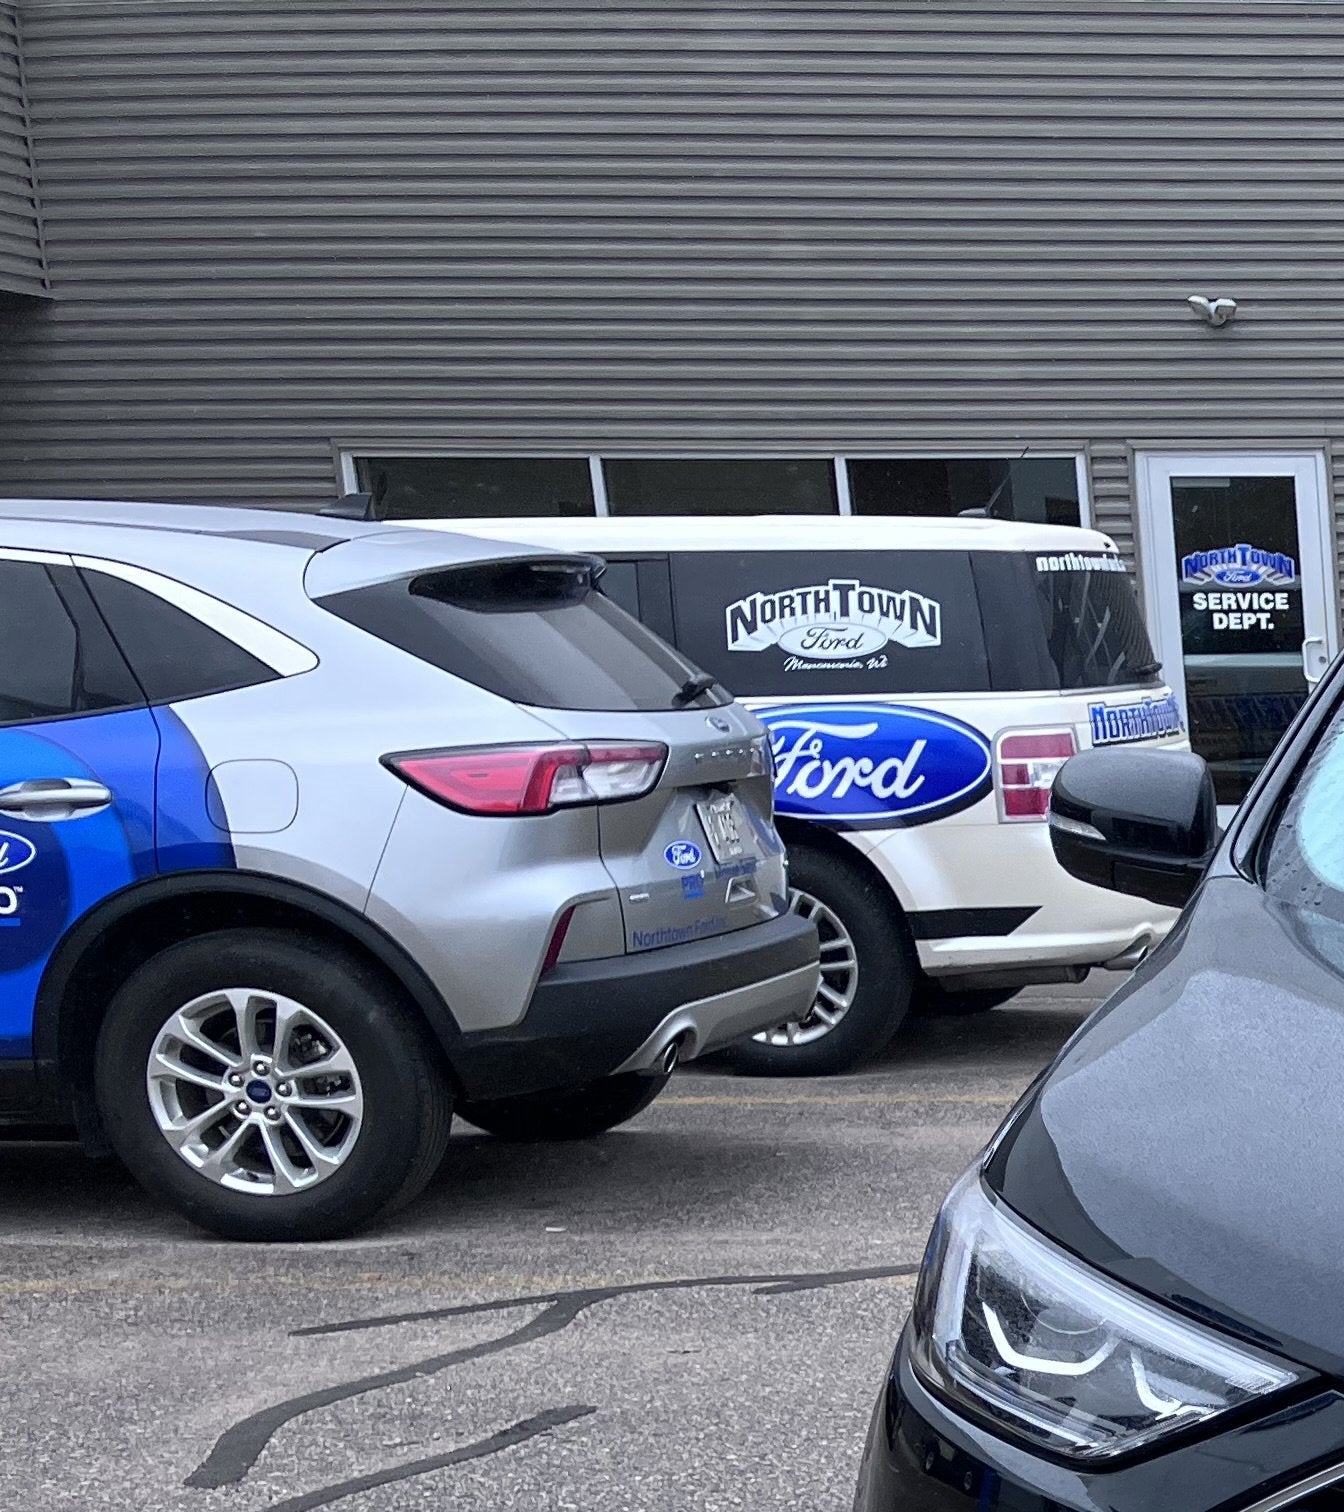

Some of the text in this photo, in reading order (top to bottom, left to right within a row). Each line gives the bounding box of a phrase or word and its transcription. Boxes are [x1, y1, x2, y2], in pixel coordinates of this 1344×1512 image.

[1193, 592, 1289, 610] SERVICE
[1212, 612, 1275, 630] DEPT.
[799, 626, 865, 651] Ford
[769, 720, 927, 799] Ford
[671, 844, 697, 866] Ford
